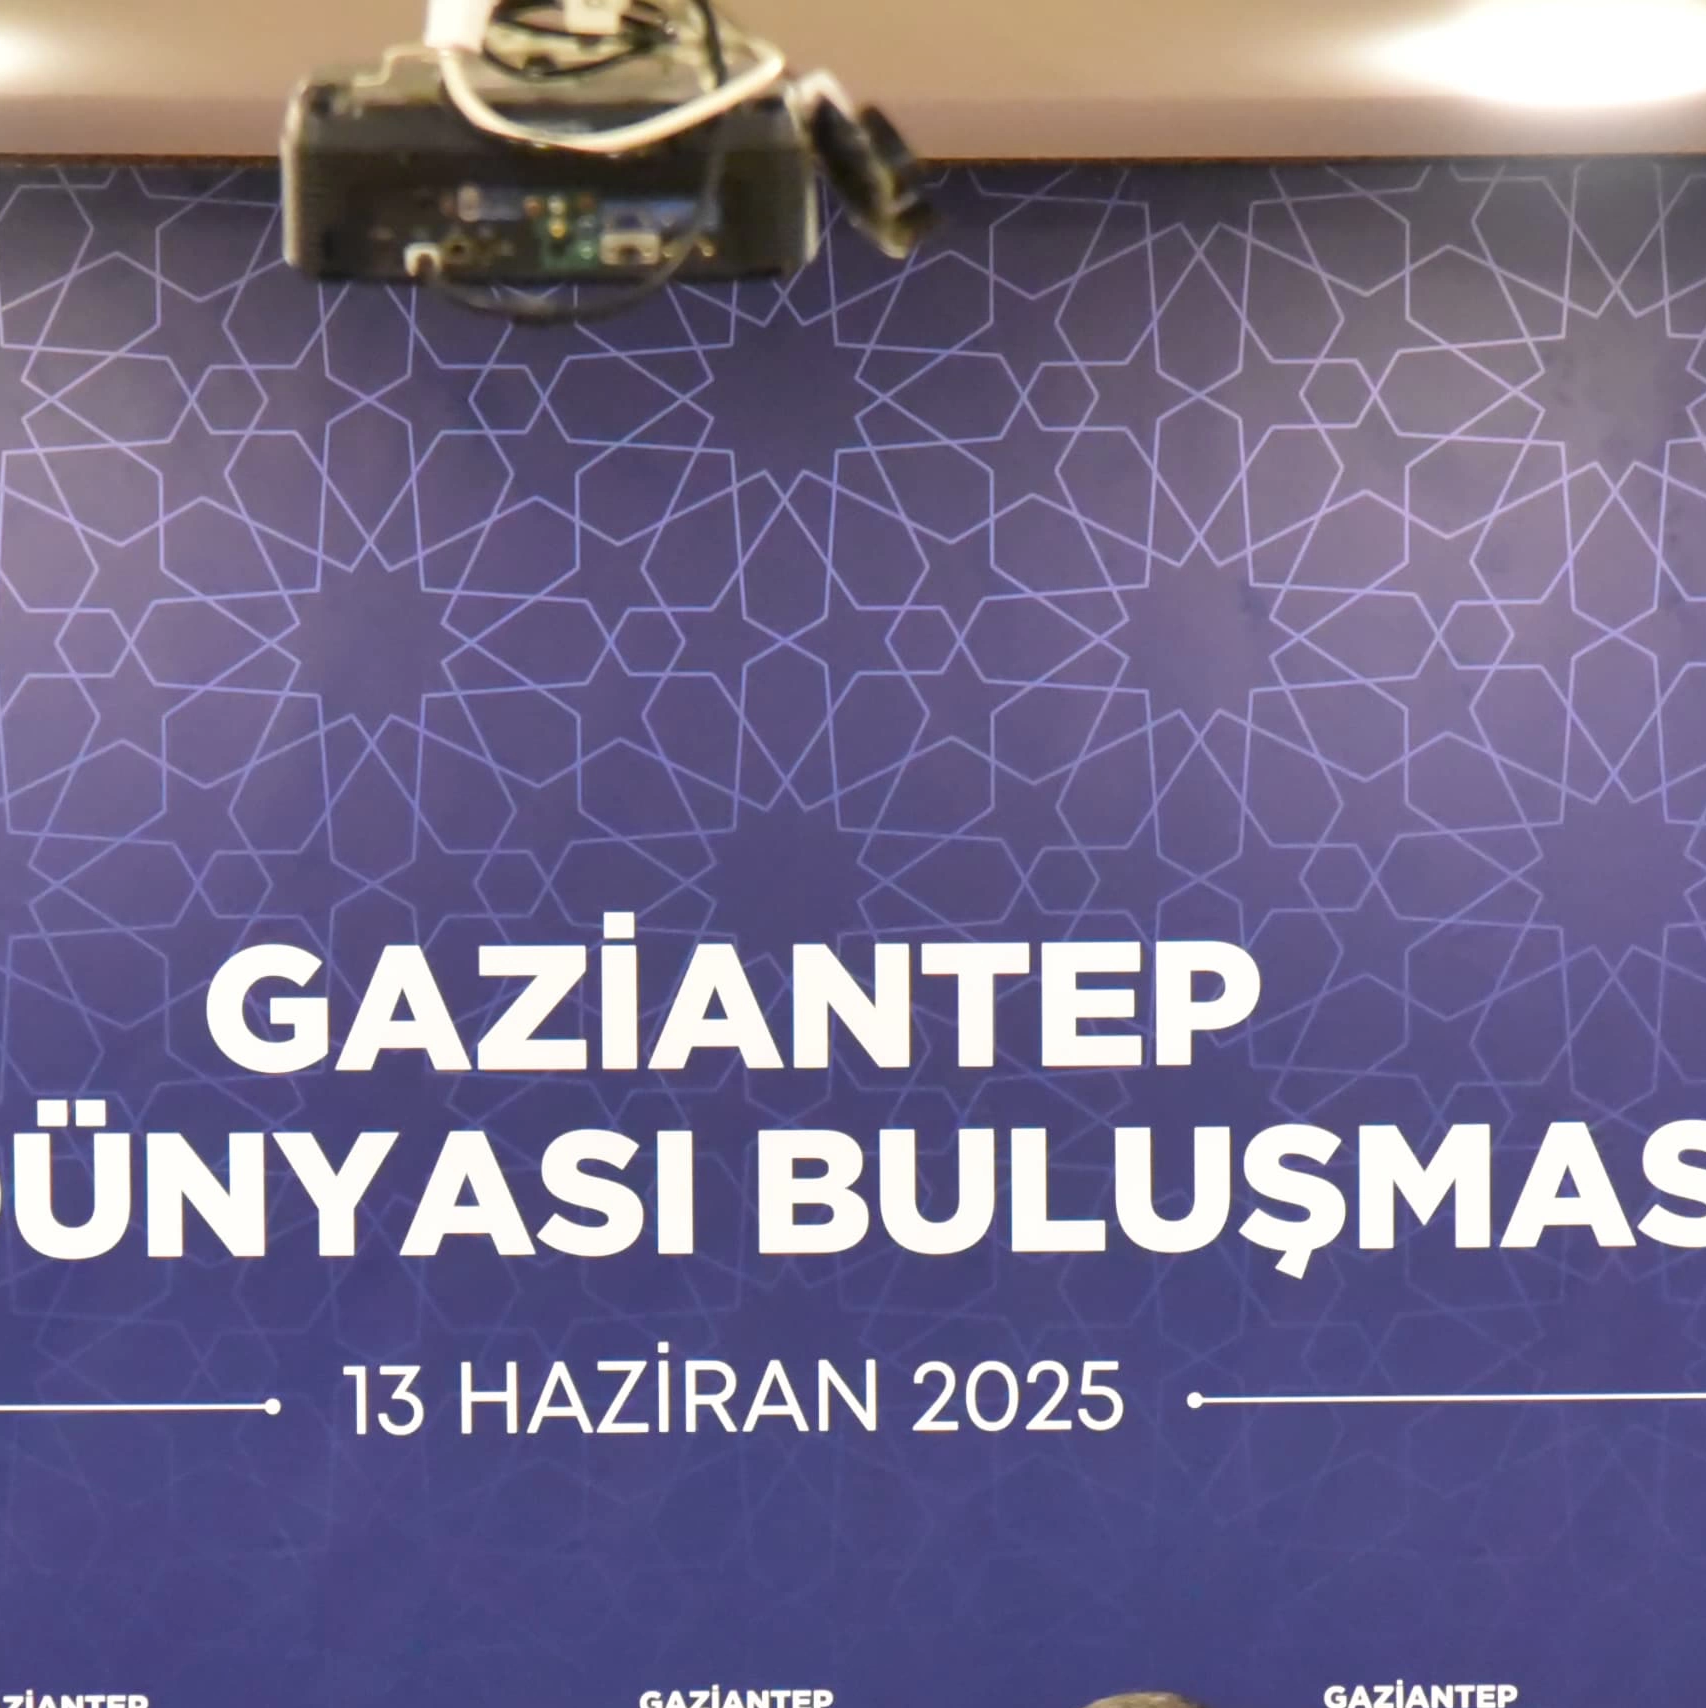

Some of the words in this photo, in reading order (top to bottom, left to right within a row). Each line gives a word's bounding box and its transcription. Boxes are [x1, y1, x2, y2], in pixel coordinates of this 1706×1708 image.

[205, 910, 1262, 1075] GAZİANTEP
[342, 1364, 425, 1437] 13
[459, 1340, 878, 1435] HAZİRAN
[911, 1359, 1125, 1433] 2025
